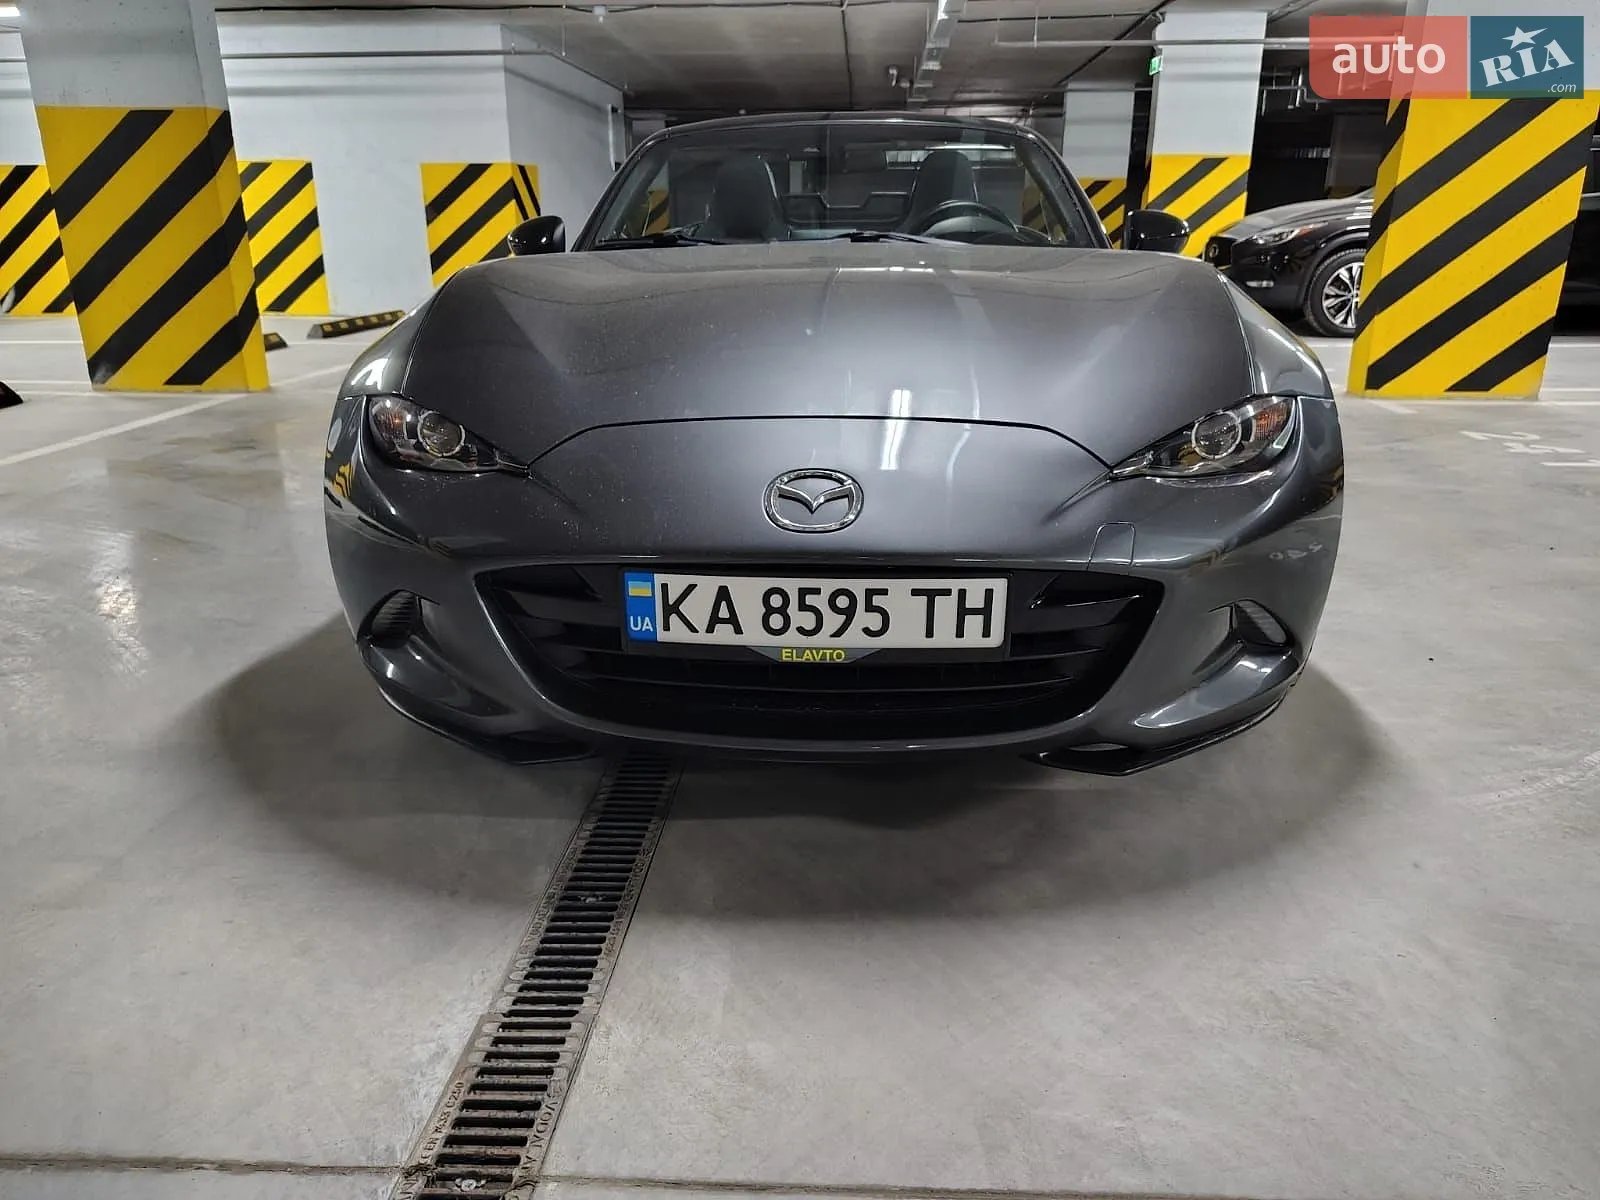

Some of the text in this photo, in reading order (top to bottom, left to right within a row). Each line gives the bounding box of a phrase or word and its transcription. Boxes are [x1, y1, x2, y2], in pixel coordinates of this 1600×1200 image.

[660, 583, 994, 639] KA 8595 TH
[630, 616, 653, 632] UA
[781, 648, 845, 662] ELAVTO
